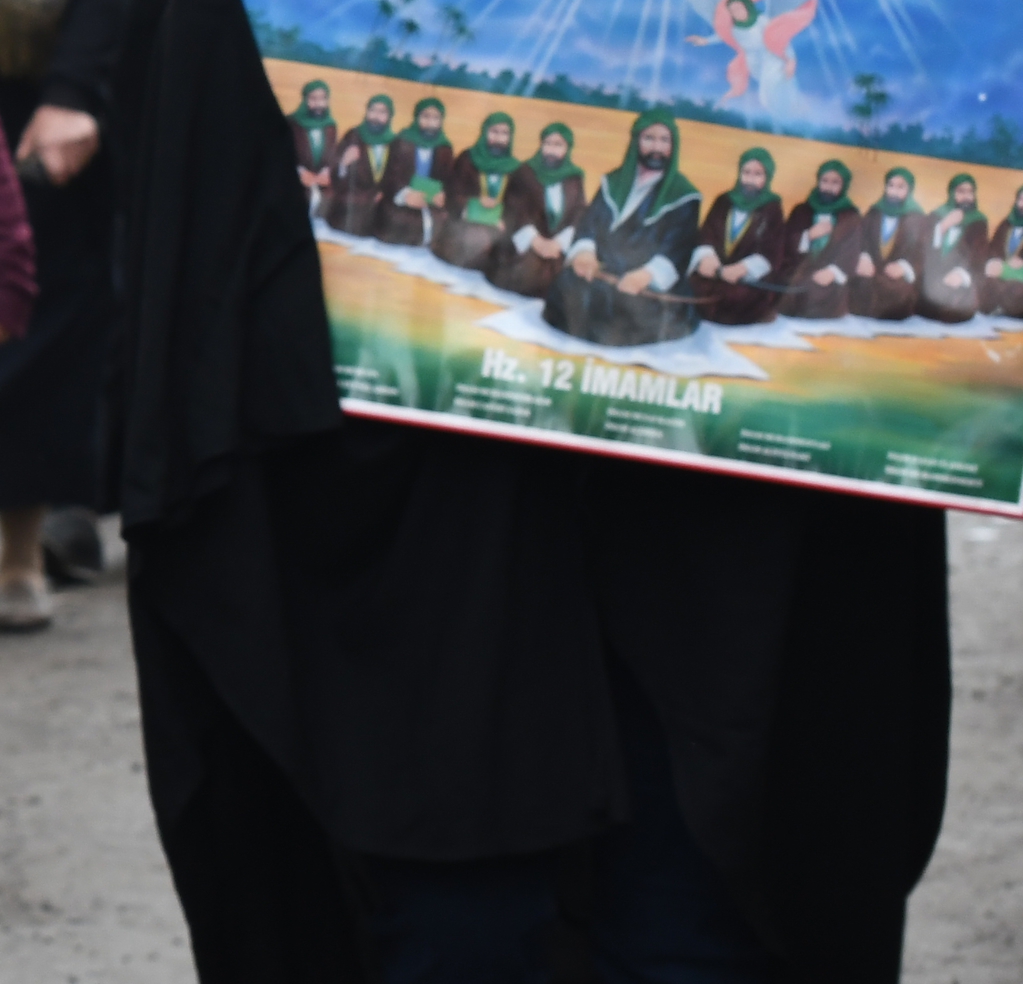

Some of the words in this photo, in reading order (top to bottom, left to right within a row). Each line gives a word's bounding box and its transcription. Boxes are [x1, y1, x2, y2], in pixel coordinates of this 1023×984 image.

[480, 347, 526, 384] Hz.
[539, 358, 574, 392] 12
[579, 356, 723, 415] İMAMLAR
